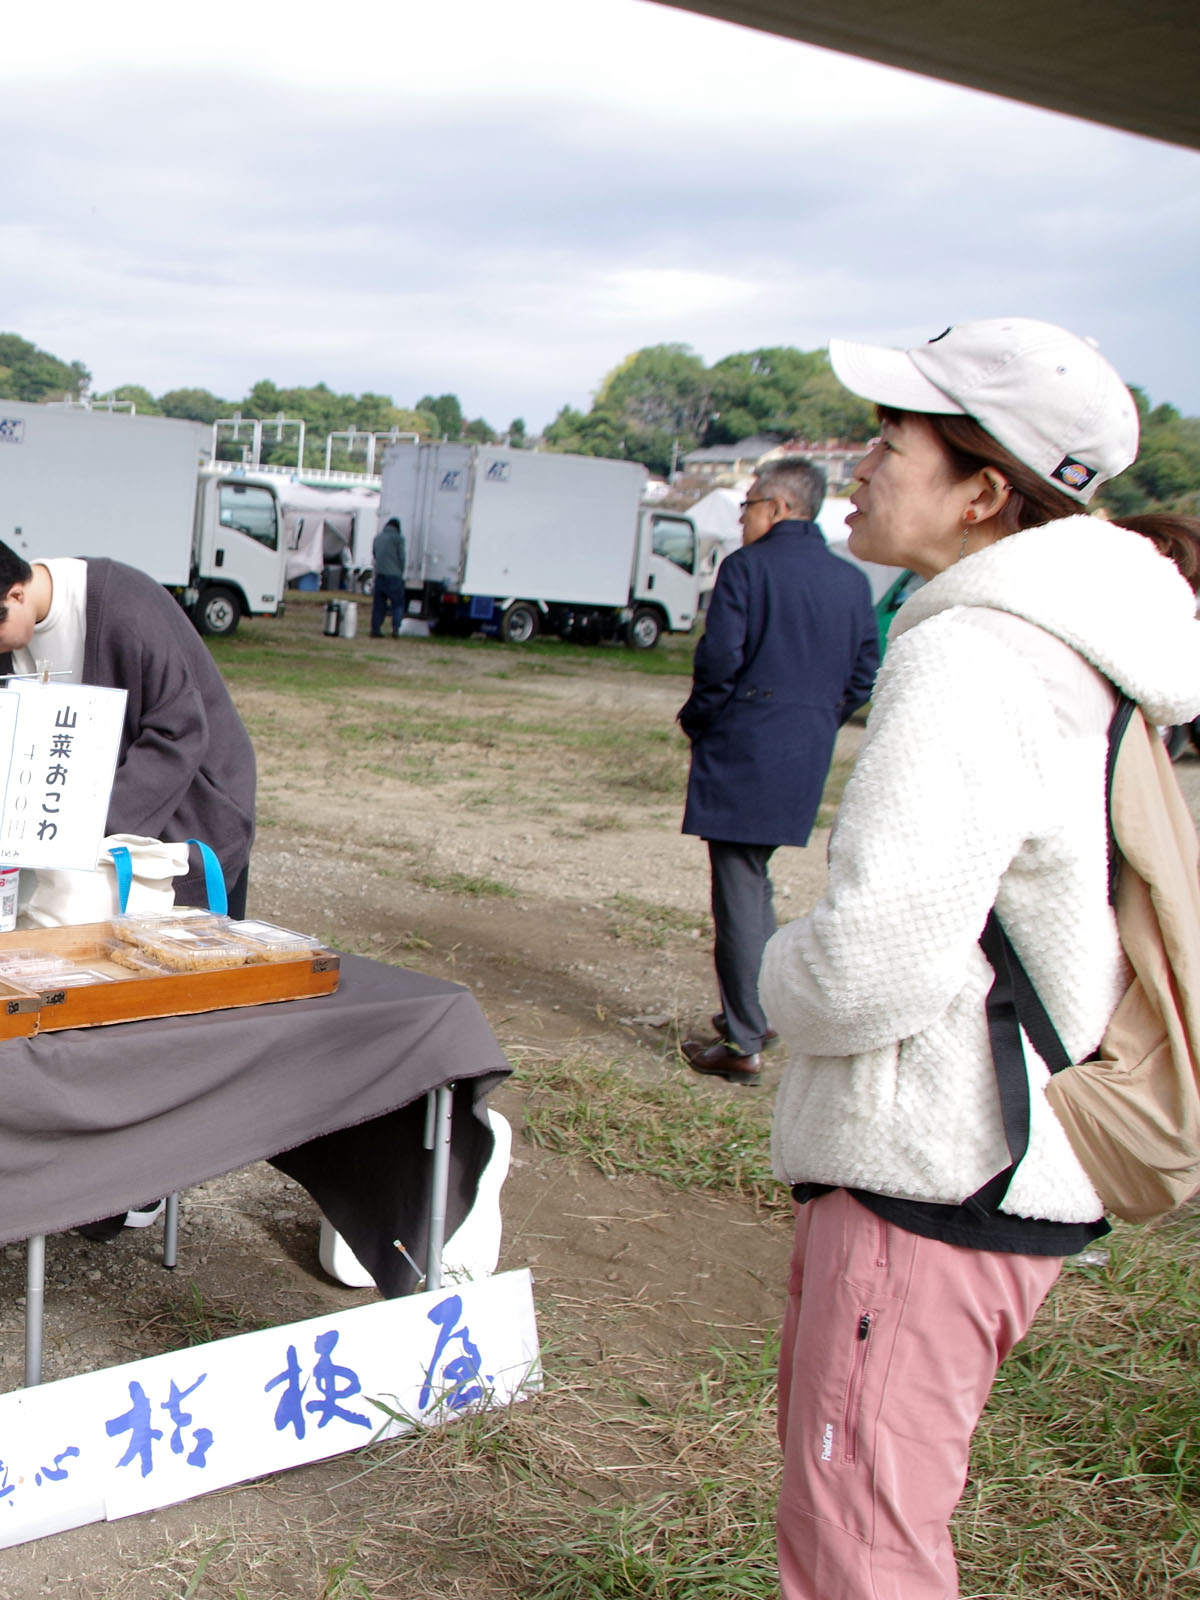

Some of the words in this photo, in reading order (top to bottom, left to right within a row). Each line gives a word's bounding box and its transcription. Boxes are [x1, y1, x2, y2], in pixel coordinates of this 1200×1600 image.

[37, 705, 78, 841] 山菜おこわ
[821, 1423, 833, 1461] FieldCore
